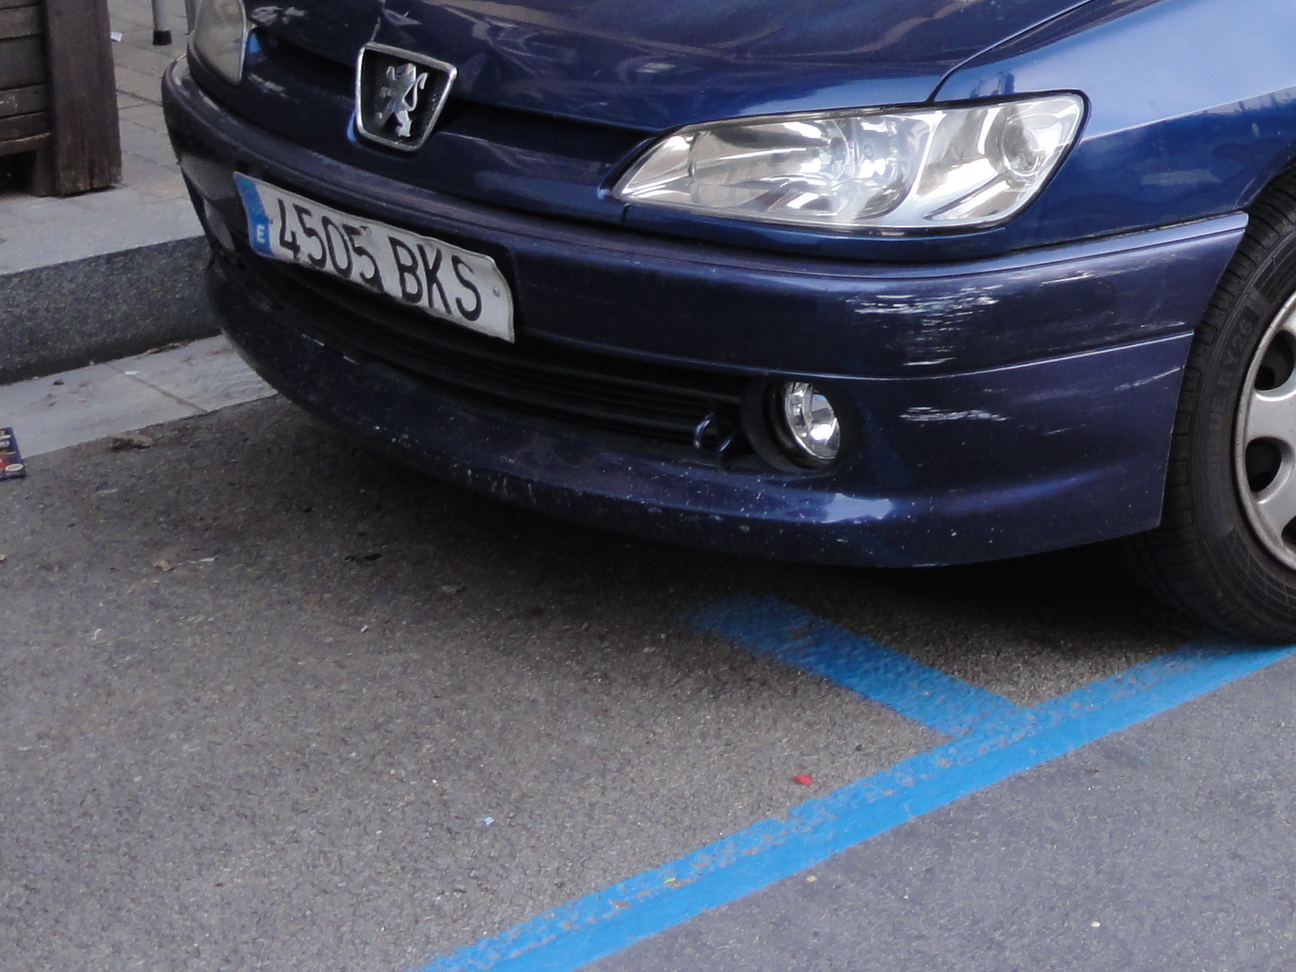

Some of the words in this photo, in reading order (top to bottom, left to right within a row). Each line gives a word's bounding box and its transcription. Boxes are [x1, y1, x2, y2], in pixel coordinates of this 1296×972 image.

[256, 224, 266, 243] E
[277, 198, 384, 294] 4505
[388, 235, 483, 322] BKS
